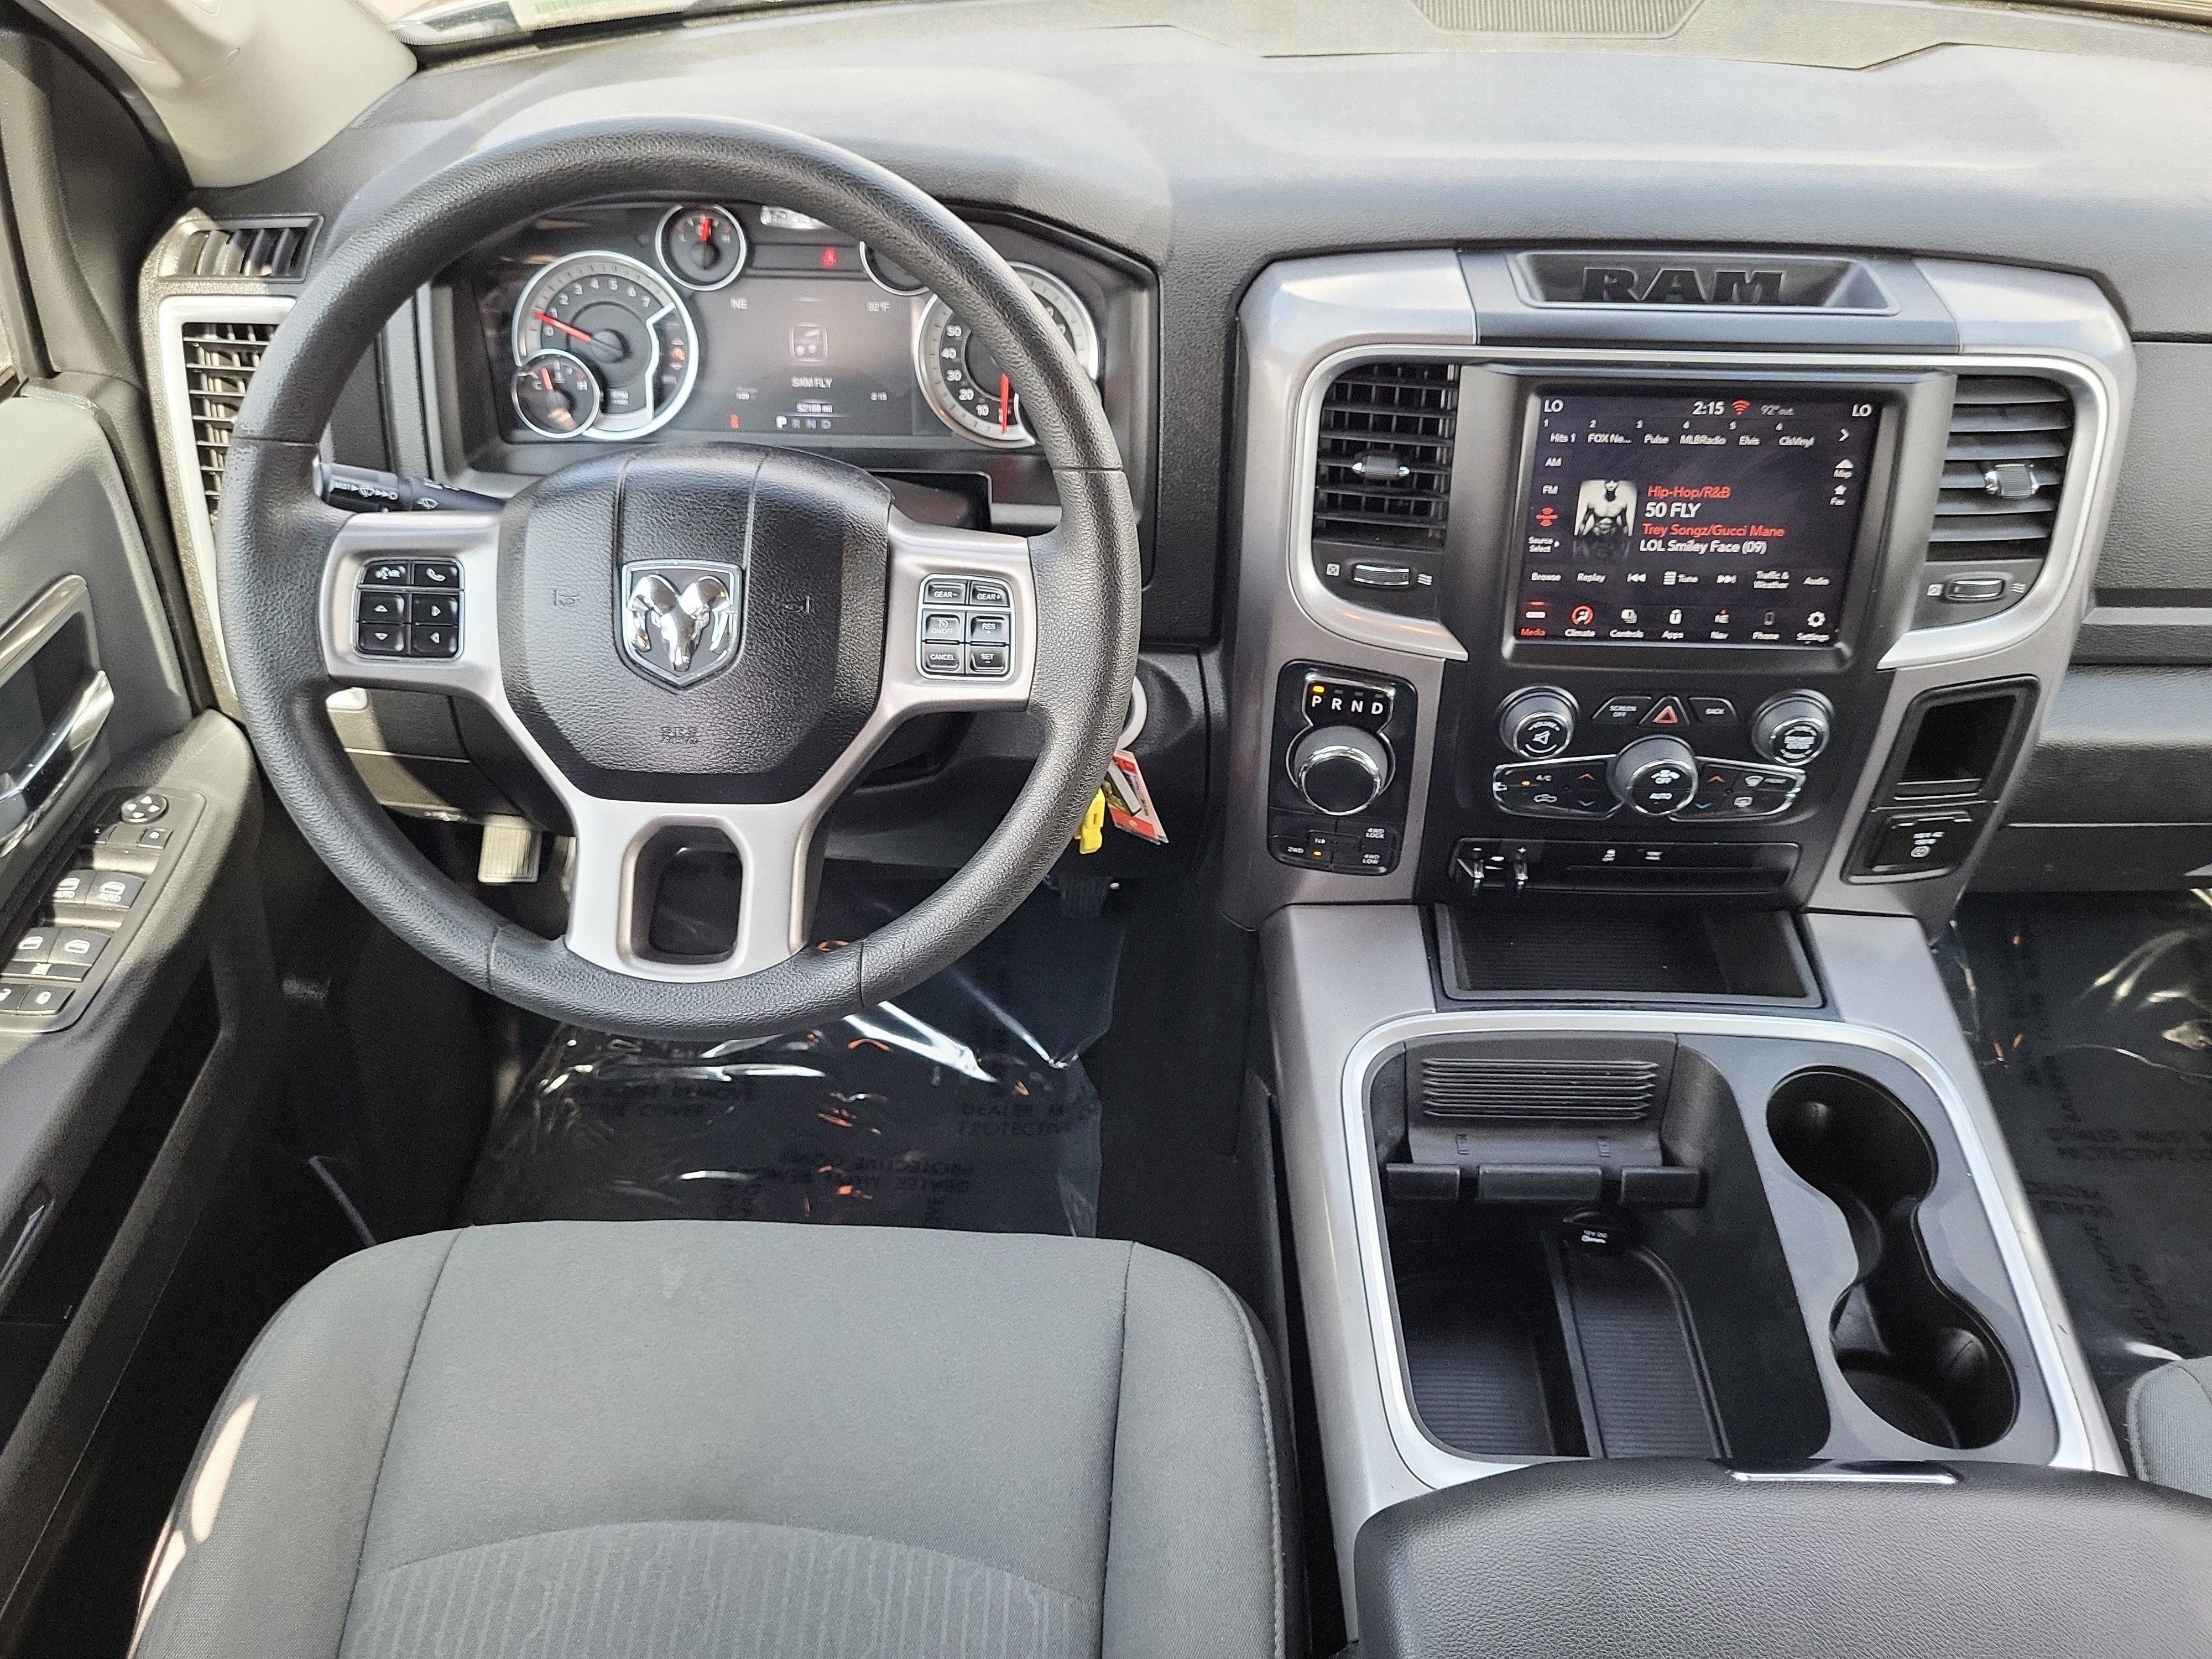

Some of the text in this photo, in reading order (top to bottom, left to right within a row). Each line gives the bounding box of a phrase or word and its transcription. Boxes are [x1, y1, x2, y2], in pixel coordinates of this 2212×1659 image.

[574, 283, 583, 295] 3
[589, 278, 599, 290] 4
[609, 278, 618, 290] 5
[1583, 267, 1787, 305] RAM
[627, 285, 636, 297] 6
[559, 293, 569, 305] 2
[642, 295, 651, 307] 7
[731, 298, 748, 310] NE
[946, 325, 962, 337] 50
[941, 347, 956, 359] 40
[946, 369, 962, 382] 30
[576, 379, 588, 390] H
[813, 377, 833, 388] FLY
[959, 388, 974, 400] 20
[976, 404, 989, 416] 10
[1544, 399, 1564, 413] LO
[1692, 401, 1725, 415] 2:15
[1851, 404, 1873, 417] LO
[776, 415, 831, 429] P R N D
[1543, 419, 1549, 427] 1
[1589, 419, 1597, 428] 2
[1636, 419, 1644, 429] 3
[1682, 420, 1690, 429] 4
[1729, 421, 1737, 430] 5
[1776, 422, 1783, 431] 6
[1550, 432, 1576, 442] Hits 1
[1587, 432, 1609, 443] FOX
[1644, 433, 1670, 444] Pulse
[1545, 457, 1562, 467] AM
[1542, 484, 1558, 494] FM
[1647, 486, 1731, 499] Hip-Hop/R&B
[1645, 502, 1702, 518] 50 FLY
[1642, 523, 1786, 538] Trey Songz/Gucci Mane
[1528, 536, 1553, 544] Source
[1528, 544, 1552, 552] Select
[1639, 539, 1666, 552] LOL
[1666, 540, 1708, 555] Smiley
[1709, 540, 1741, 552] Face
[1531, 572, 1562, 581] Browse
[1577, 572, 1606, 583] Replay
[1677, 573, 1699, 583] Tune
[1803, 577, 1830, 586] Audio
[1521, 628, 1546, 637] Media
[1564, 628, 1596, 637] Climate
[1609, 629, 1644, 638] Controls
[1661, 630, 1684, 640] Apps
[1752, 632, 1780, 640] Phone
[1311, 696, 1384, 714] P R N D
[961, 1102, 1033, 1117] DEALER
